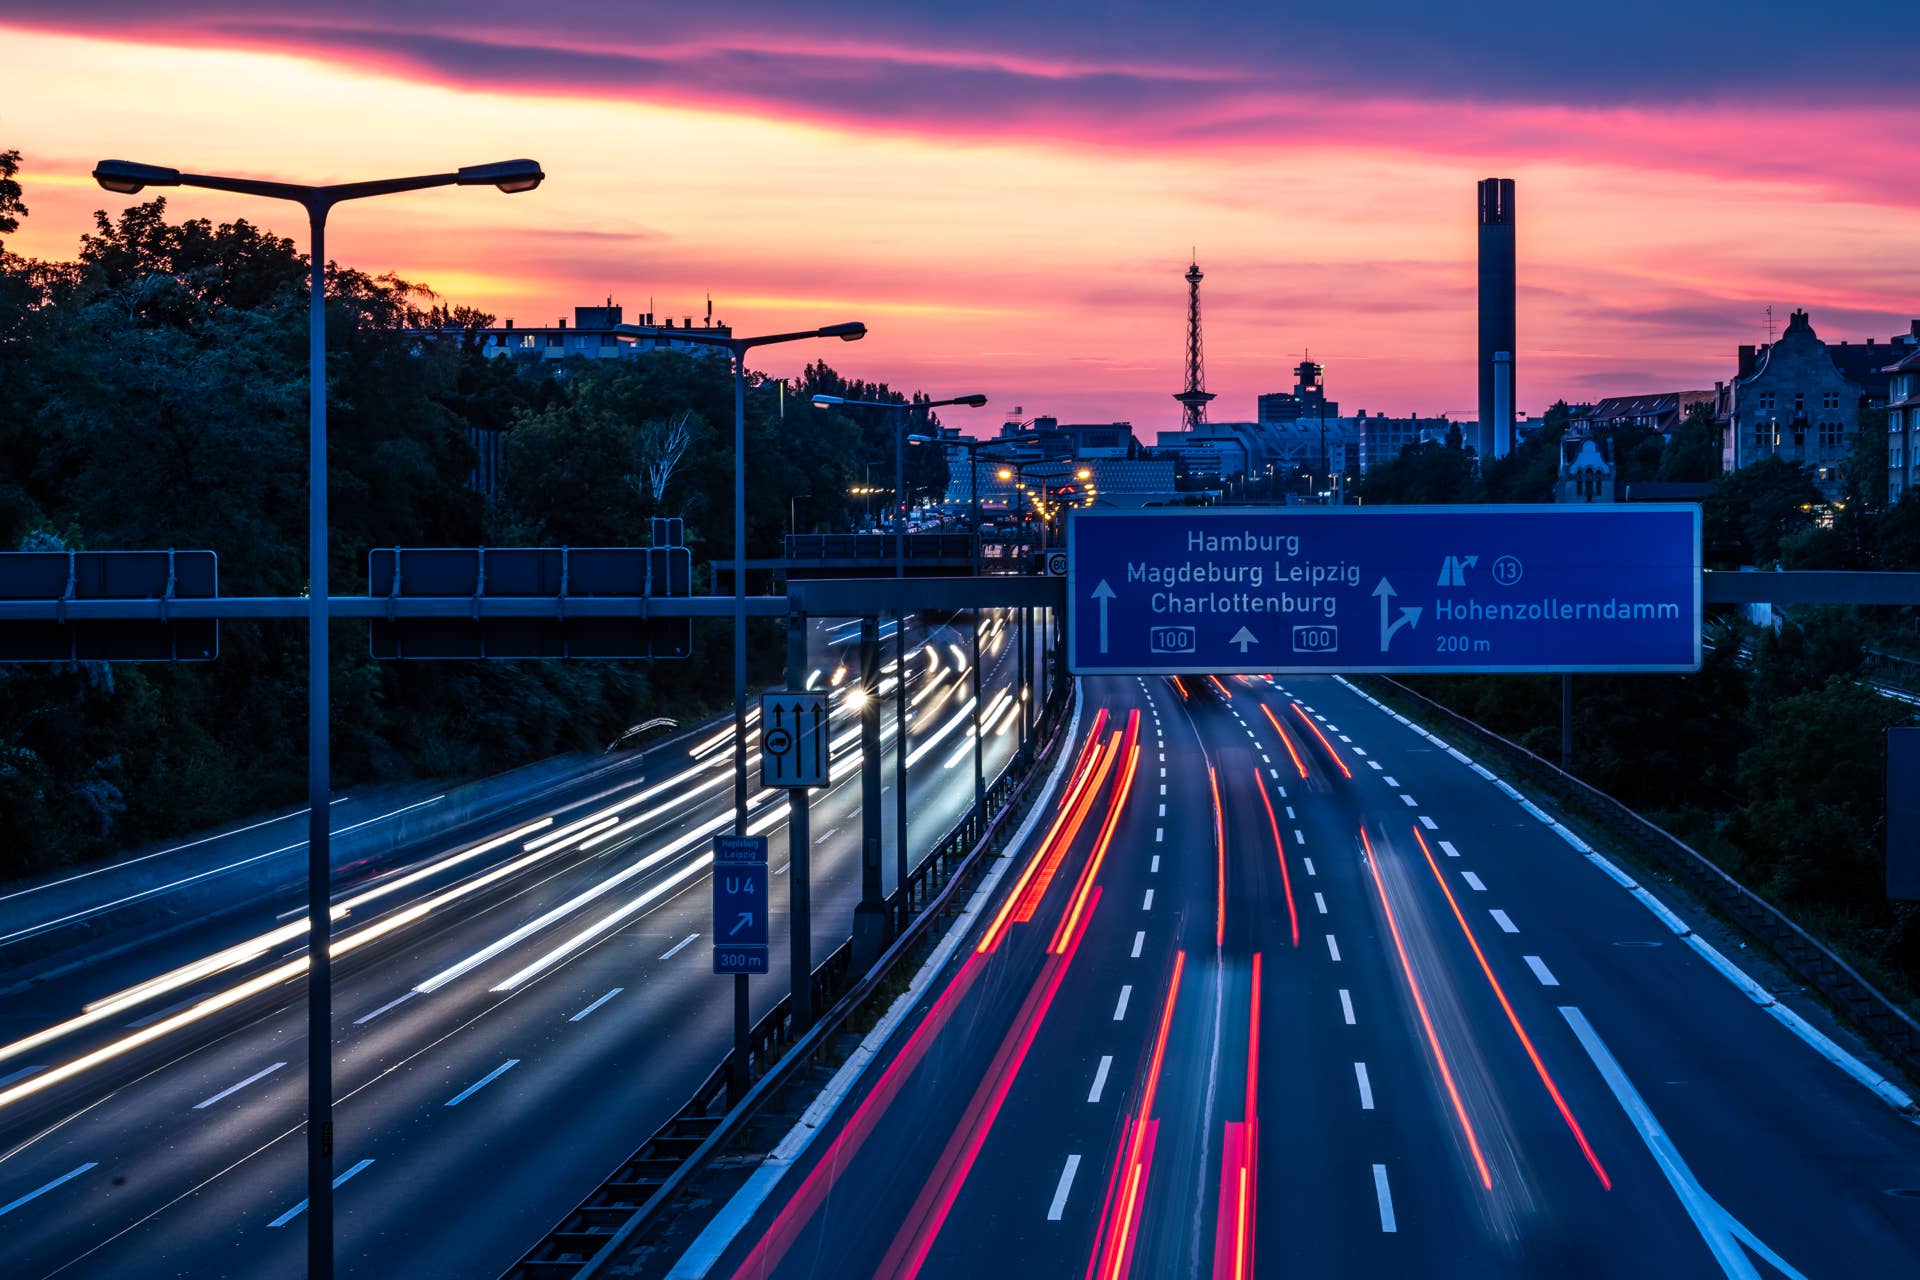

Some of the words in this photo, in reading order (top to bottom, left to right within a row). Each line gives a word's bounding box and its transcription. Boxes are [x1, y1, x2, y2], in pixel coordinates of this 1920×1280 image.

[1187, 530, 1299, 556] Hamburg
[1053, 559, 1066, 570] 80
[1499, 562, 1516, 579] 13
[1127, 561, 1263, 588] Magdeburg
[1275, 560, 1361, 587] Leipzig
[1151, 591, 1337, 618] Charlottenburg
[1436, 598, 1680, 621] Hohenzollerndamm
[1159, 631, 1188, 648] 100
[1301, 630, 1330, 647] 100
[1436, 636, 1469, 652] 200
[1474, 640, 1491, 652] m
[726, 877, 739, 894] U
[743, 877, 755, 894] 4
[721, 954, 745, 967] 300
[749, 956, 761, 966] m
